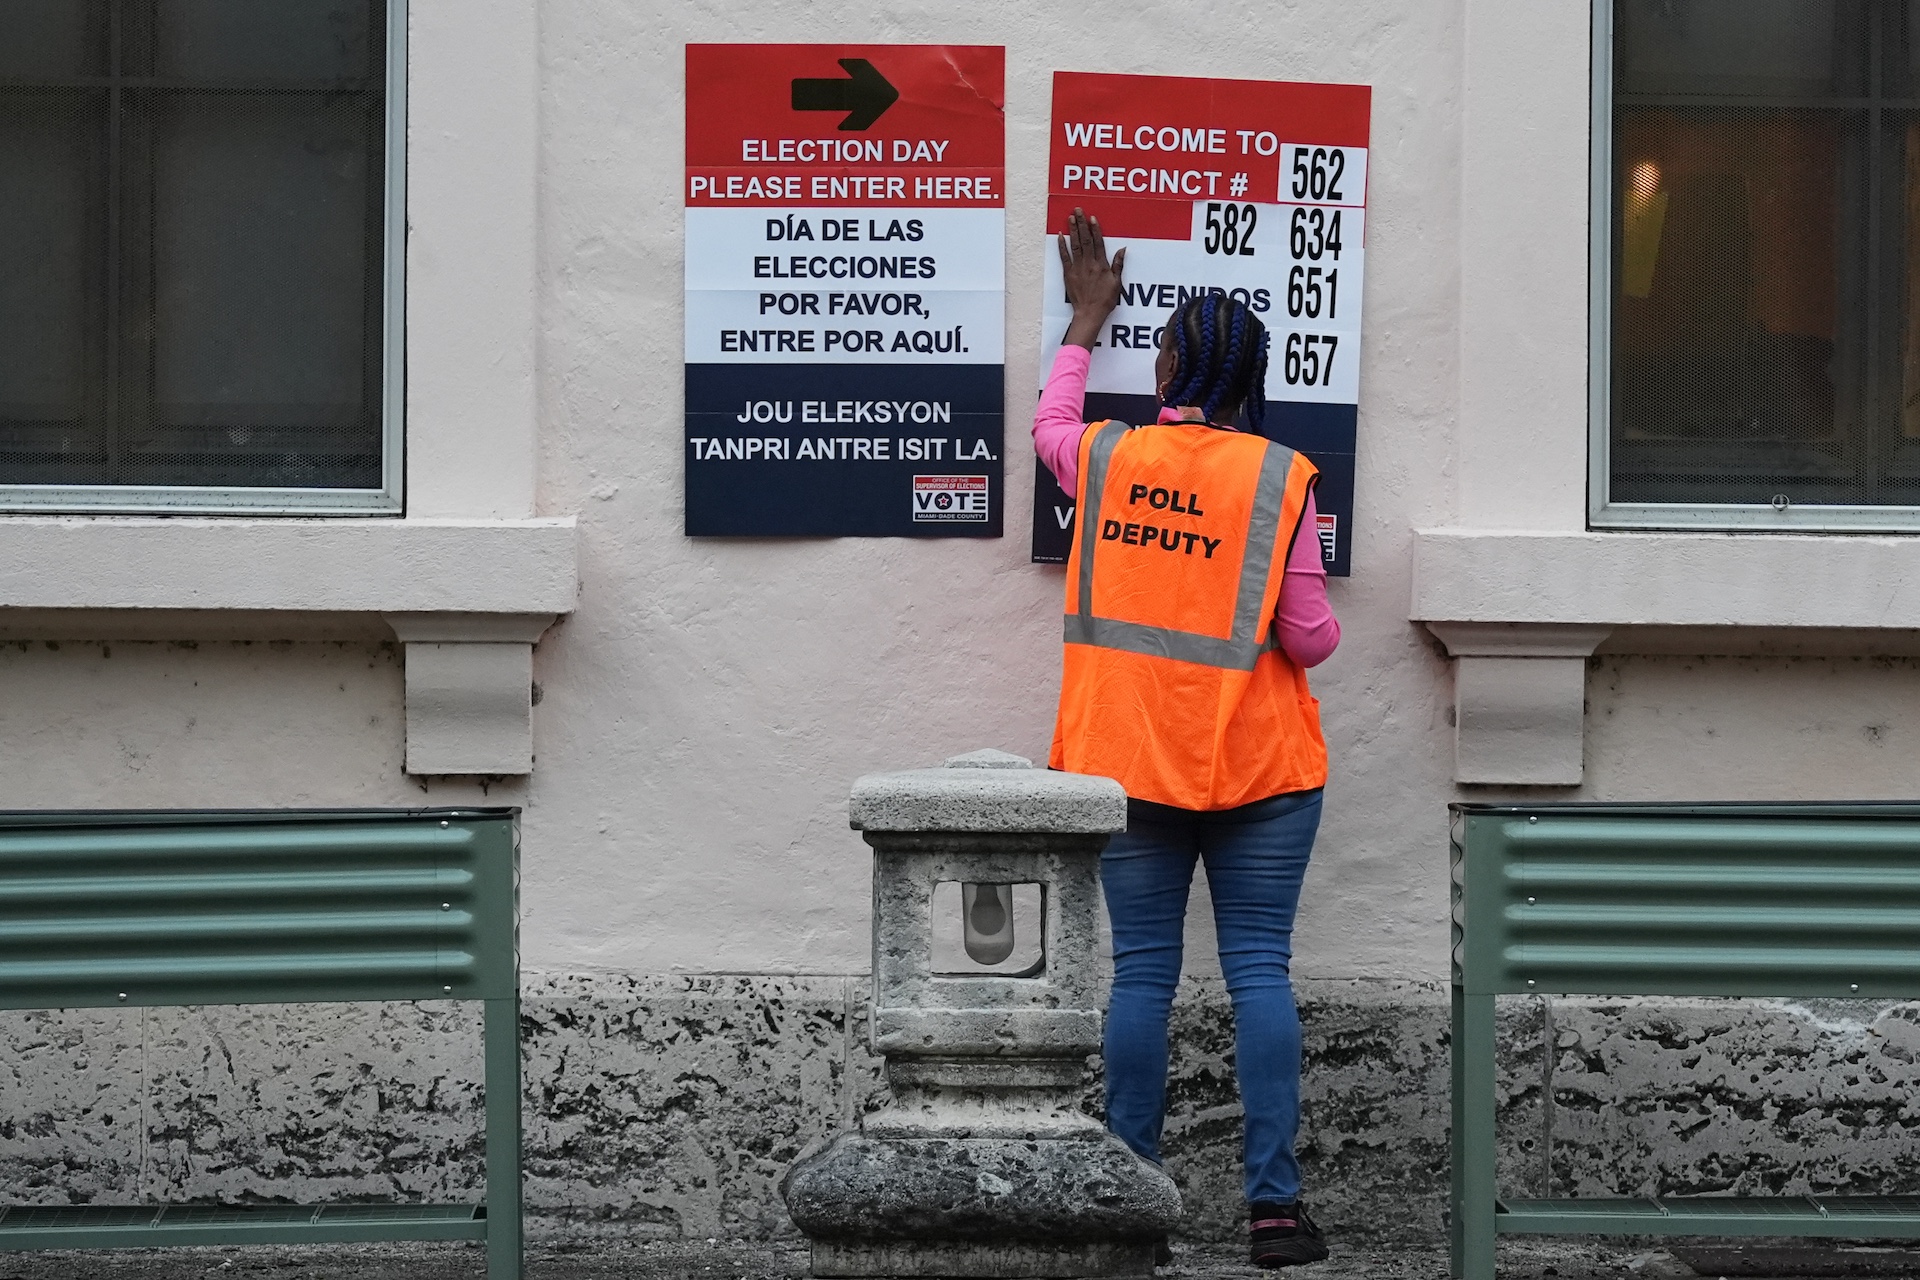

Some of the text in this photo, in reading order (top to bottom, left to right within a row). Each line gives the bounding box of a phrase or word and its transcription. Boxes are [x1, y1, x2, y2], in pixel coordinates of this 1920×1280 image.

[742, 139, 949, 162] ELECTION DAY
[1064, 123, 1278, 156] WELCOME TO
[690, 176, 999, 199] PLEASE ENTER HERE.
[1063, 165, 1249, 197] PRECINCT #
[1291, 147, 1345, 201] 562
[766, 214, 924, 241] DÍA DE LAS
[1204, 203, 1257, 256] 582
[1290, 208, 1342, 261] 634
[754, 256, 936, 278] ELECCIONES
[760, 293, 930, 319] POR FAVOR,
[1287, 265, 1338, 319] 651
[721, 325, 969, 354] ENTRE POR AQUÍ.
[1285, 333, 1338, 387] 657
[737, 401, 951, 424] JOU ELEKSYON
[690, 438, 997, 460] TANPRI ANTRE ISIT LA.
[915, 492, 986, 510] VOTE
[1129, 484, 1203, 516] POLL
[1102, 520, 1222, 559] DEPUTY
